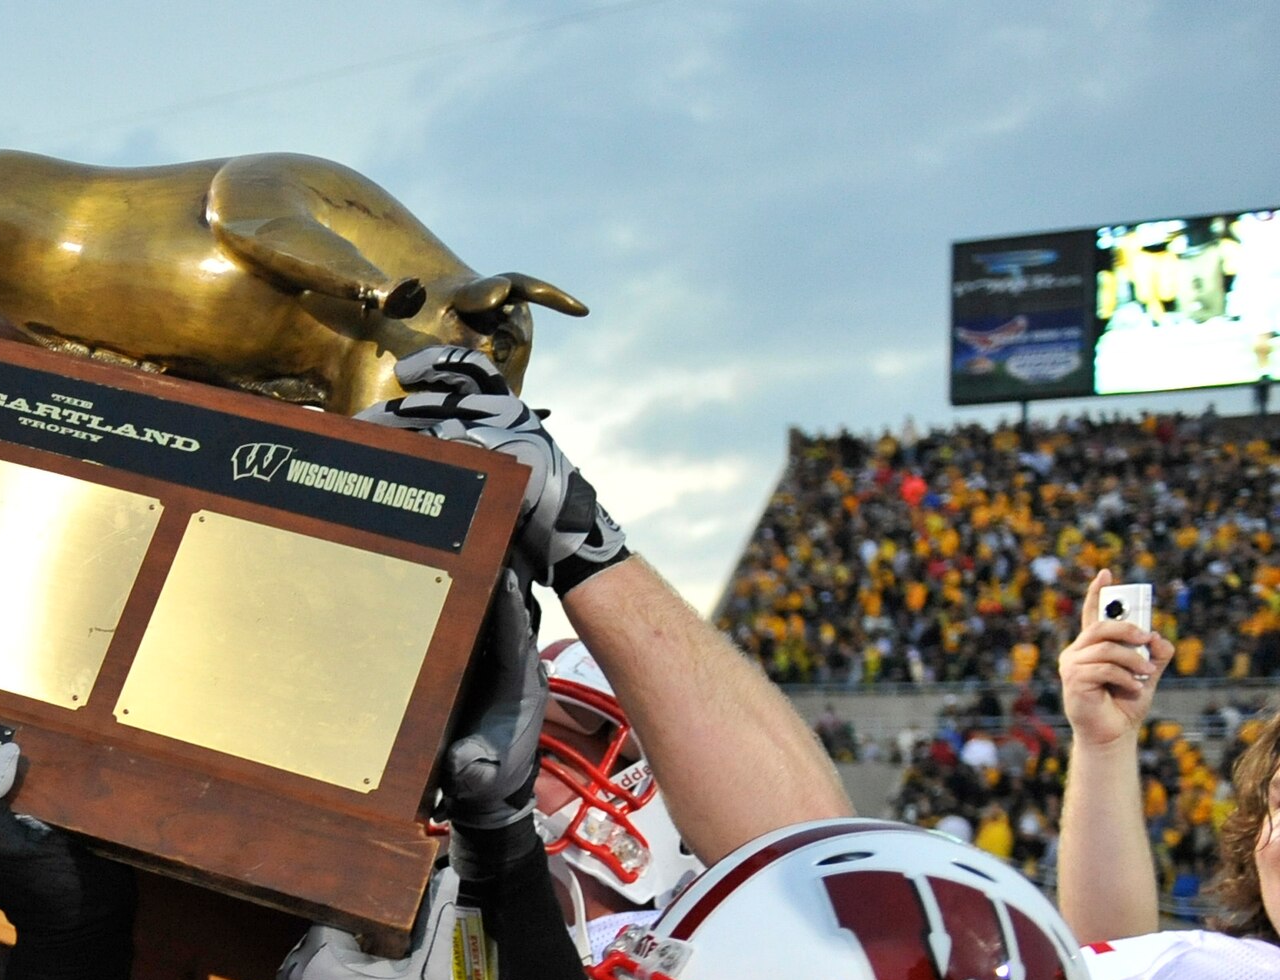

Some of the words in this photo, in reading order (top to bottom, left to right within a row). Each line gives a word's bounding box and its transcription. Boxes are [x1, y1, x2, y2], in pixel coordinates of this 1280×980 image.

[50, 392, 93, 410] THE
[18, 416, 103, 443] TROPHY
[286, 458, 372, 499] WISCONSIN
[372, 480, 446, 518] BADGERS
